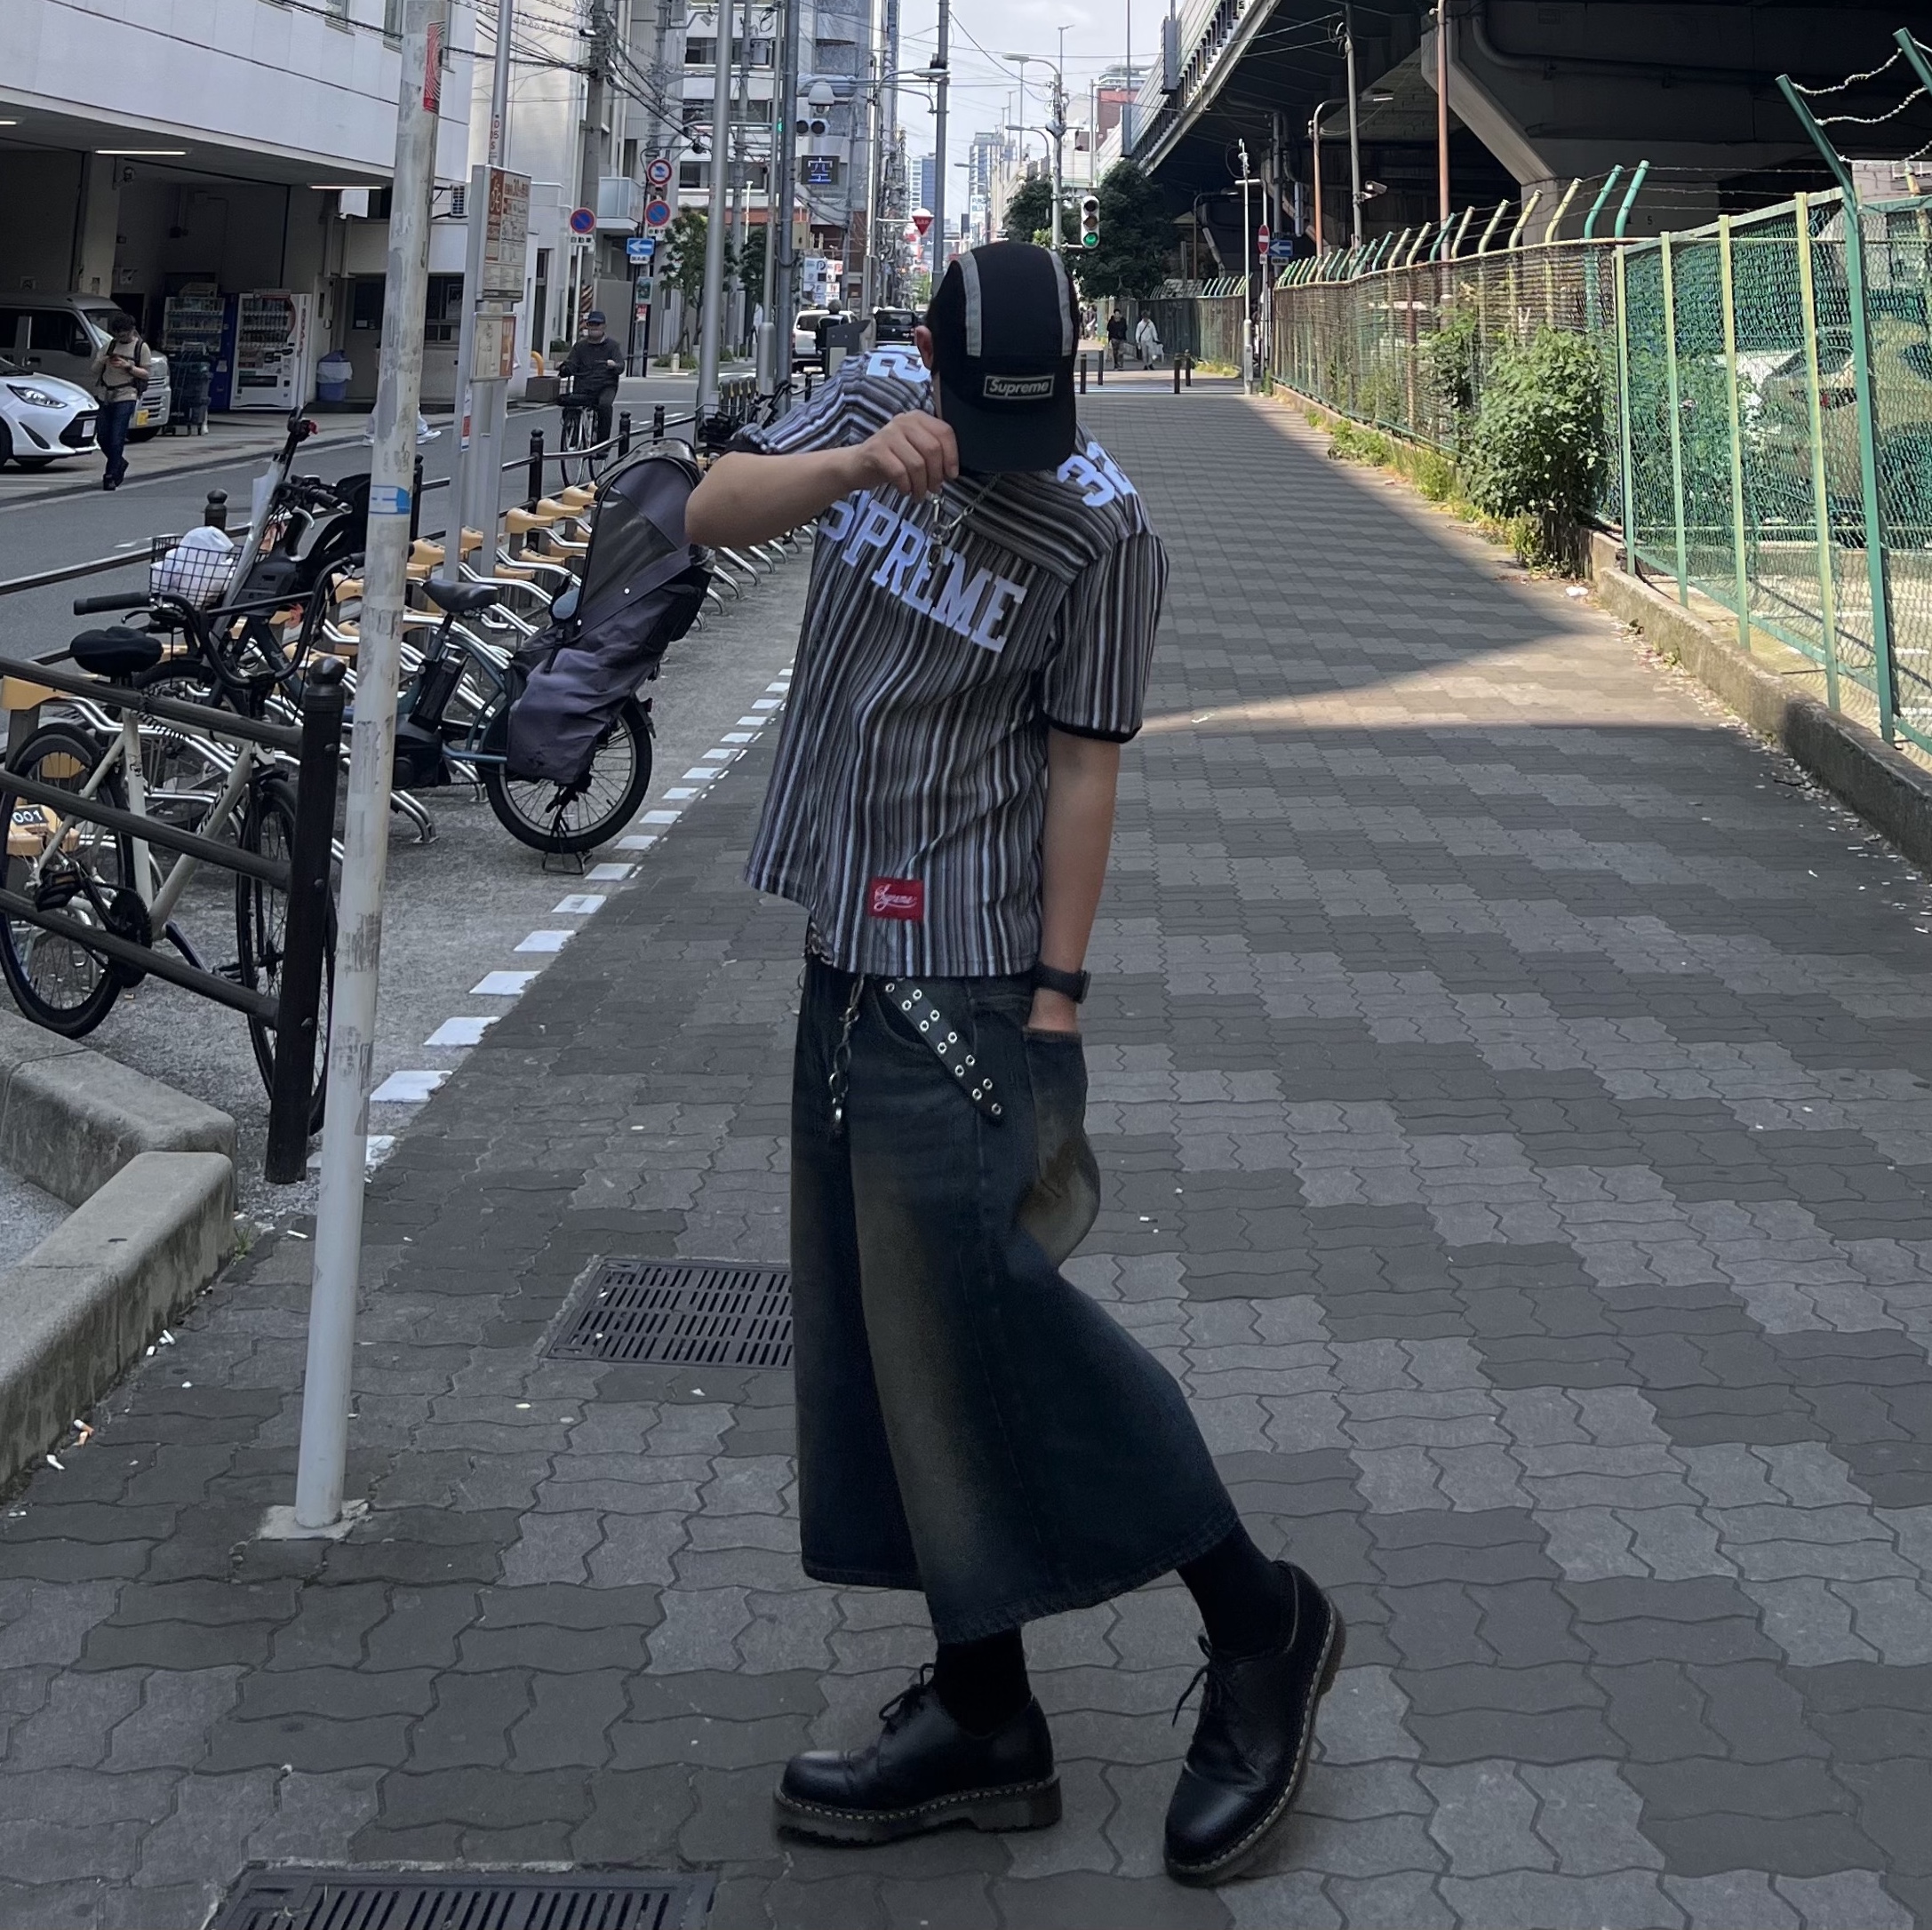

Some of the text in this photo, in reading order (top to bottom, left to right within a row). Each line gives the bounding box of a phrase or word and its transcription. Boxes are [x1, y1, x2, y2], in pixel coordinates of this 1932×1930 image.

[807, 156, 833, 182] 空
[989, 378, 1050, 397] Supreme
[12, 809, 44, 824] 001
